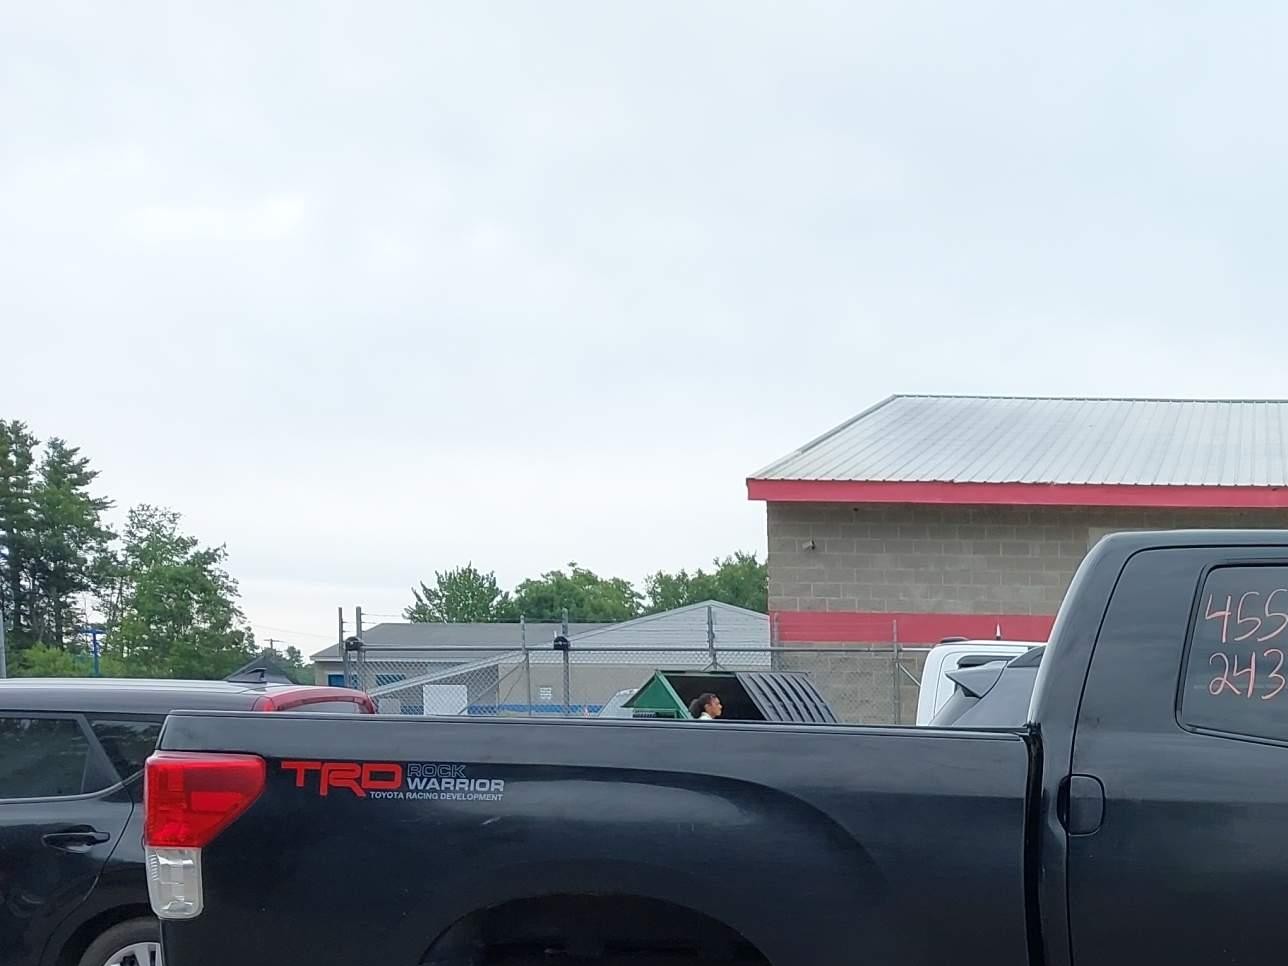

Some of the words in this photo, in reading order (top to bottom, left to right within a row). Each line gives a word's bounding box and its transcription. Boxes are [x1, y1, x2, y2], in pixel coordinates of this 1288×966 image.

[407, 764, 466, 777] ROCK
[281, 761, 402, 797] TRD
[407, 778, 505, 791] WARRIOR
[370, 791, 404, 799] TOYOTA
[406, 792, 438, 800] RACING
[440, 793, 504, 801] DEVELOPMENT
